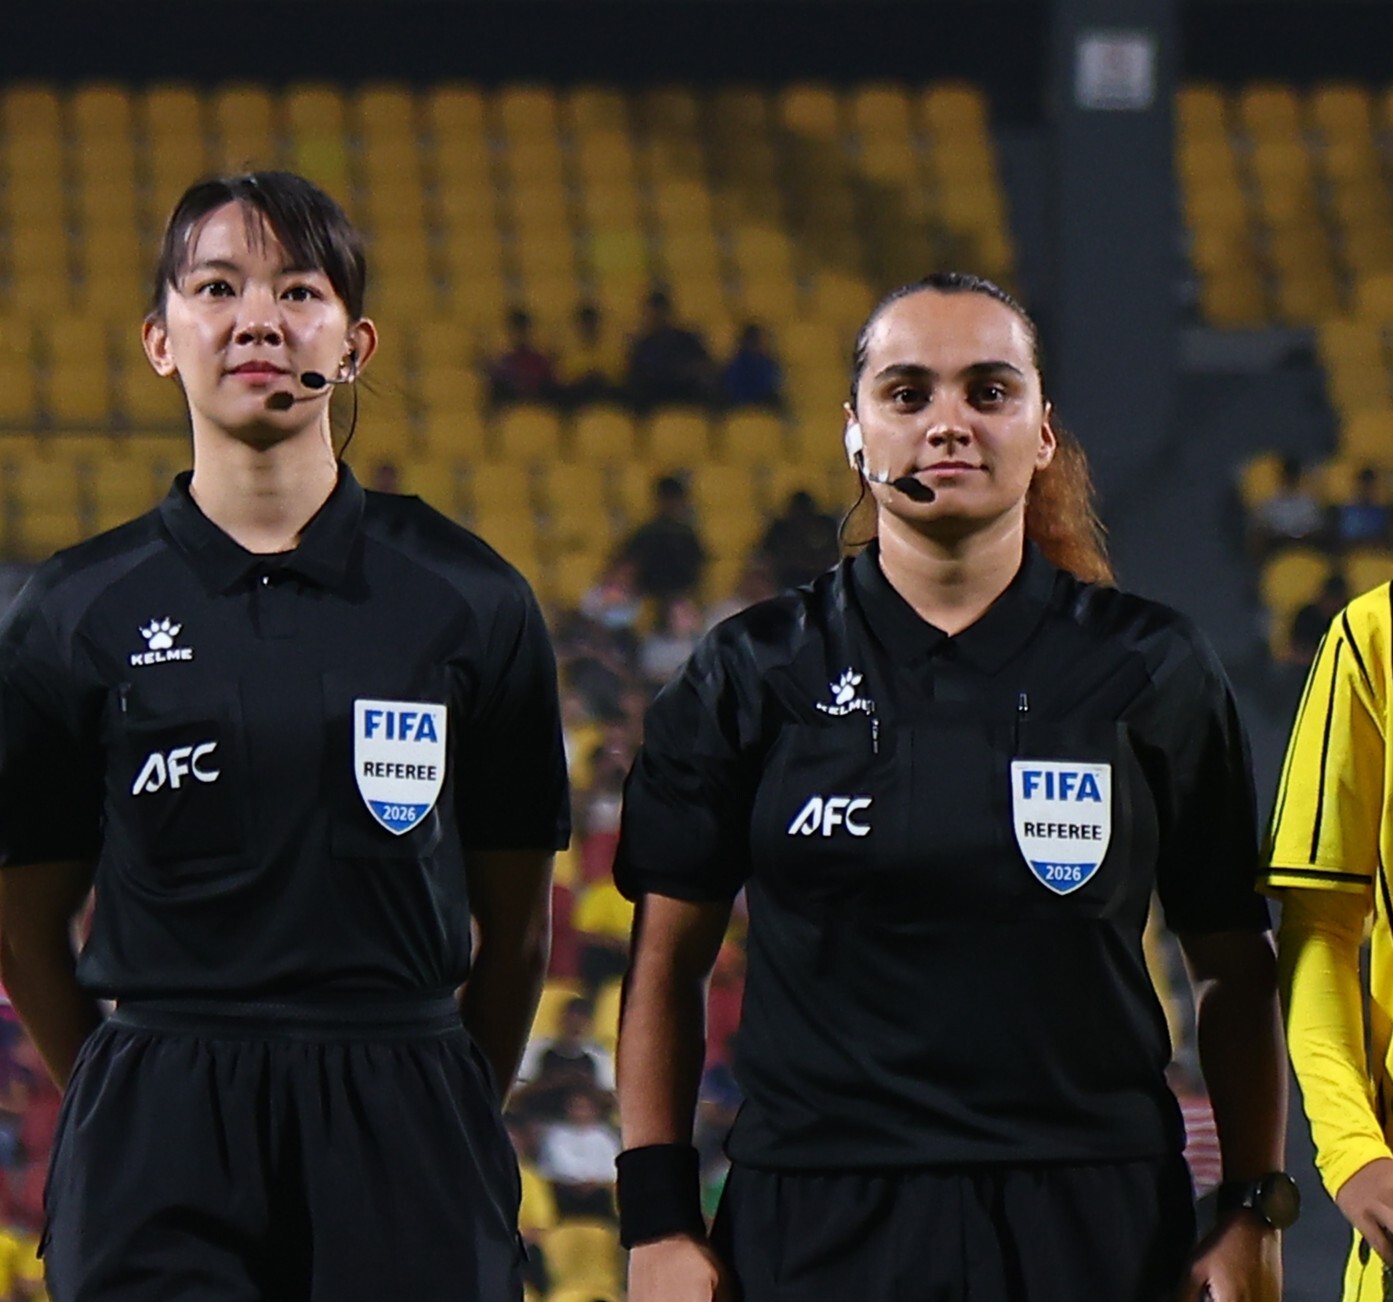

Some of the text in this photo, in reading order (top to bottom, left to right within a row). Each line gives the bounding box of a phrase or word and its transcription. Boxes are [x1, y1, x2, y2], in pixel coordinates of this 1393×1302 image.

[131, 649, 193, 666] KELME
[363, 709, 438, 743] FIFA
[132, 742, 221, 795] AFC
[363, 761, 437, 781] REFEREE
[1022, 770, 1103, 802] FIFA
[383, 804, 416, 822] 2026
[788, 797, 872, 837] AFC
[1024, 822, 1102, 841] REFEREE
[1046, 865, 1081, 882] 2026
